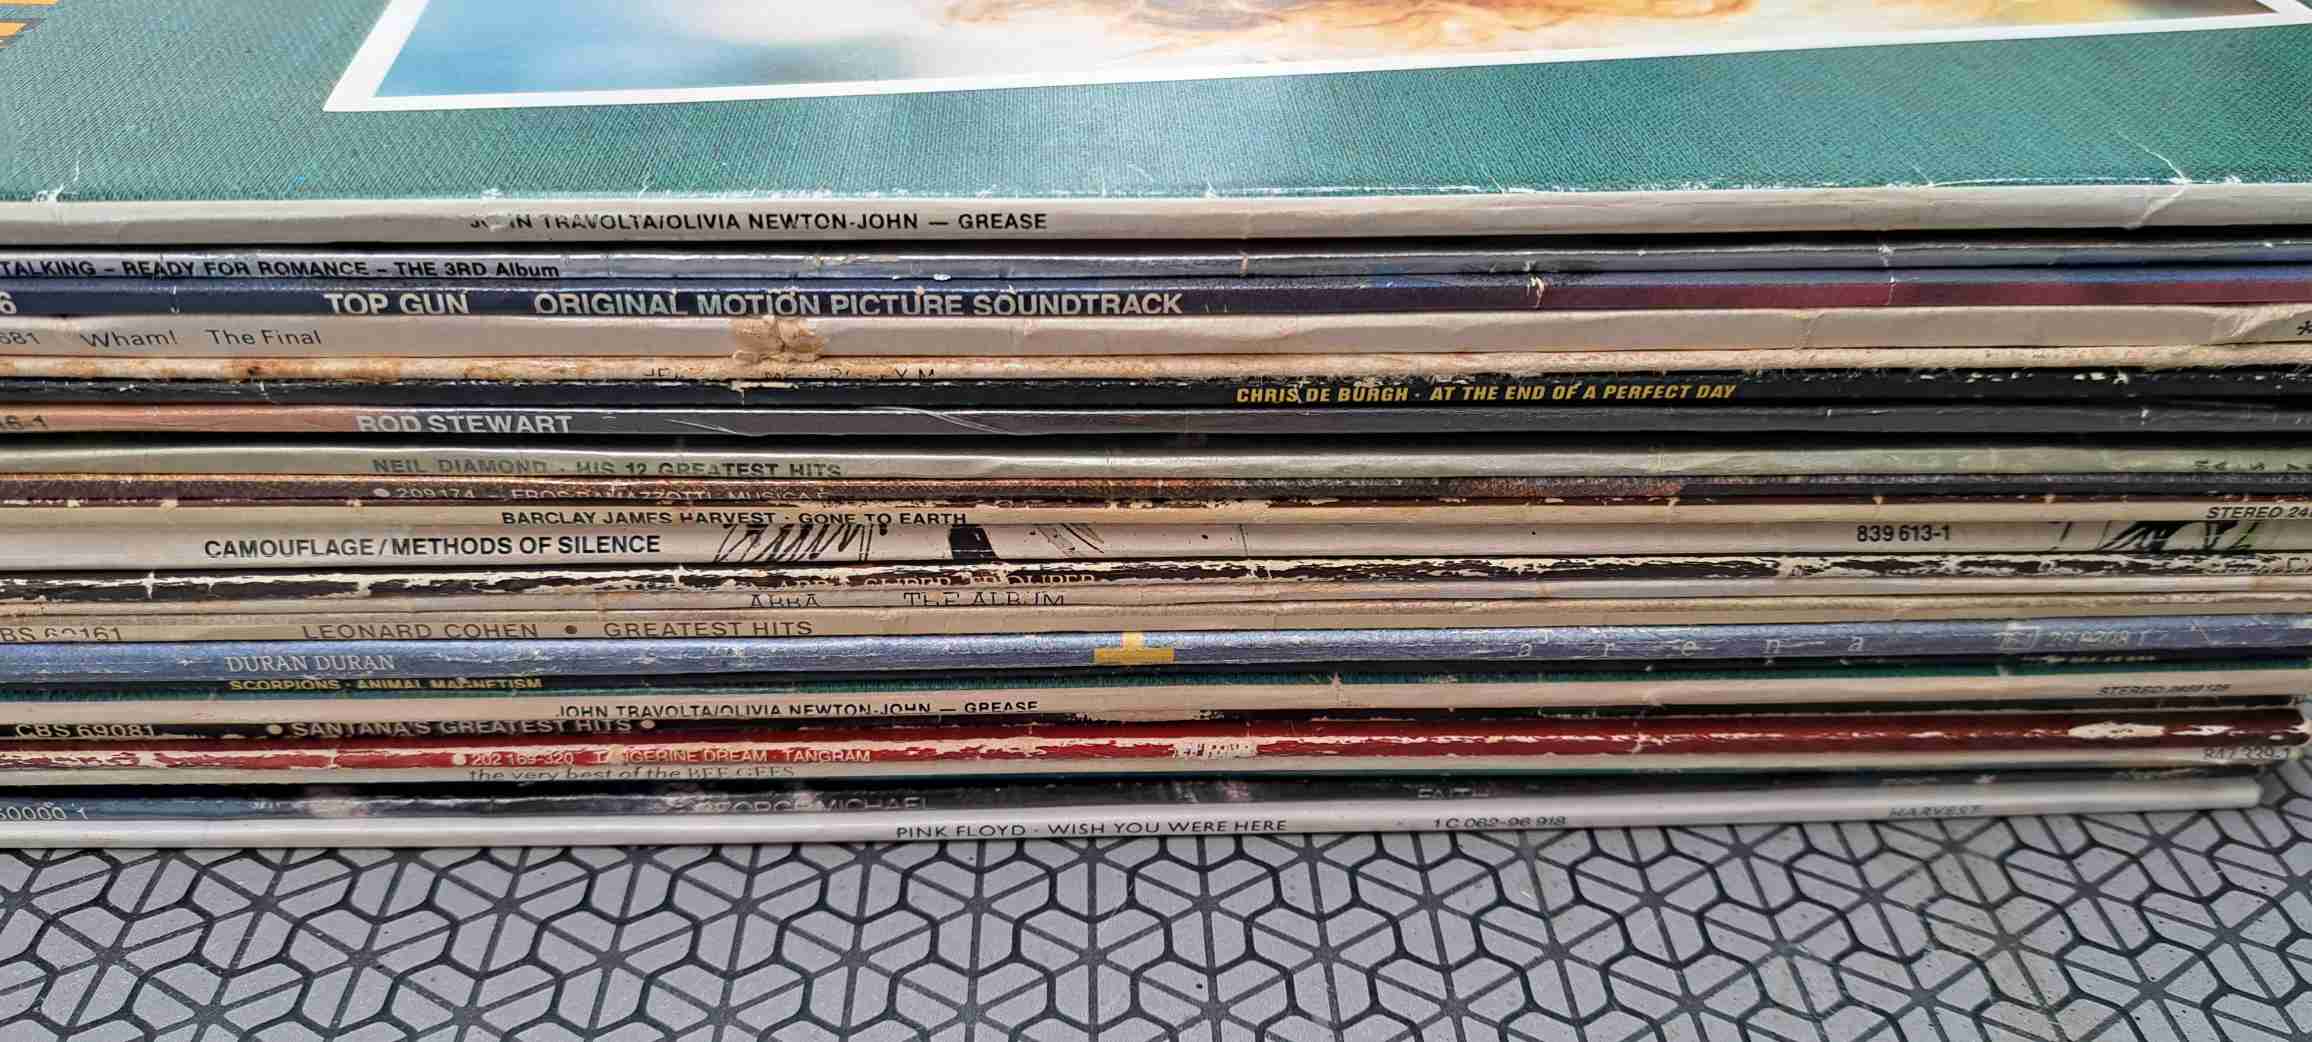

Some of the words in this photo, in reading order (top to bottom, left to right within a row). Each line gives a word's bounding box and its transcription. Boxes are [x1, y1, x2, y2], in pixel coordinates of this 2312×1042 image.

[748, 212, 918, 230] NEWTON-JOHN
[957, 212, 1048, 230] GREASE
[0, 260, 97, 276] TALKING
[122, 260, 195, 278] READY
[203, 261, 250, 277] FOR
[258, 262, 370, 277] ROMANCE
[394, 261, 439, 277] THE
[445, 262, 487, 277] 3RD
[494, 262, 560, 278] Album
[322, 292, 389, 315] TOP
[400, 291, 471, 315] GUN
[533, 292, 689, 315] ORIGINAL
[697, 292, 820, 315] MOTION
[830, 292, 965, 316] PICTURE
[973, 292, 1183, 316] SOUNDTRACK
[80, 329, 177, 348] Wham!
[205, 329, 256, 345] The
[262, 330, 322, 345] Final
[1236, 387, 1298, 402] CHRIS
[1306, 387, 1332, 402] DE
[1337, 386, 1409, 402] BURGH
[1430, 386, 1458, 401] AT
[1462, 386, 1499, 401] THE
[1504, 385, 1546, 401] END
[1551, 384, 1577, 401] OF
[1582, 384, 1597, 400] A
[1602, 384, 1692, 400] PERFECT
[1695, 384, 1737, 399] DAY
[355, 415, 422, 433] ROD
[427, 414, 573, 433] STEWART
[372, 458, 428, 473] NEIL
[437, 459, 548, 474] DIAMOND
[575, 461, 616, 474] HIS
[626, 461, 649, 475] 12
[657, 462, 780, 478] GREATEST
[789, 463, 843, 478] HITS
[501, 511, 597, 525] BARCLAY
[603, 512, 673, 525] JAMES
[679, 511, 777, 525] HARVEST
[798, 512, 856, 525] GONE
[864, 512, 893, 525] TO
[900, 512, 967, 525] EARTH
[2207, 505, 2284, 519] STEREO
[1856, 524, 1895, 542] 839
[1899, 524, 1951, 542] 613-1
[519, 536, 552, 555] OF
[557, 534, 661, 555] SILENCE
[301, 624, 433, 640] LEONARD
[443, 623, 538, 639] COHEN
[603, 621, 744, 638] GREATEST
[752, 620, 814, 637] HITS
[223, 655, 308, 672] DURAN
[314, 654, 396, 671] DURAN
[229, 679, 341, 690] SCORPIONS
[357, 678, 423, 689] ANIMAL
[15, 724, 72, 738] CBS
[77, 724, 156, 738] 69081
[290, 721, 432, 738] SANTANA'S
[440, 719, 567, 735] GREATEST
[576, 718, 633, 733] HITS
[593, 750, 698, 765] TGERINE
[703, 749, 769, 763] DREAM
[784, 749, 871, 763] TANGRAM
[469, 768, 506, 781] the
[512, 769, 560, 781] very
[566, 767, 612, 780] best
[647, 766, 682, 779] the
[896, 824, 948, 839] PINK
[956, 823, 1027, 838] FLOYD
[1048, 822, 1105, 836] WISH
[1113, 821, 1160, 834] YOU
[1167, 820, 1229, 833] WERE
[1234, 819, 1288, 833] HERE
